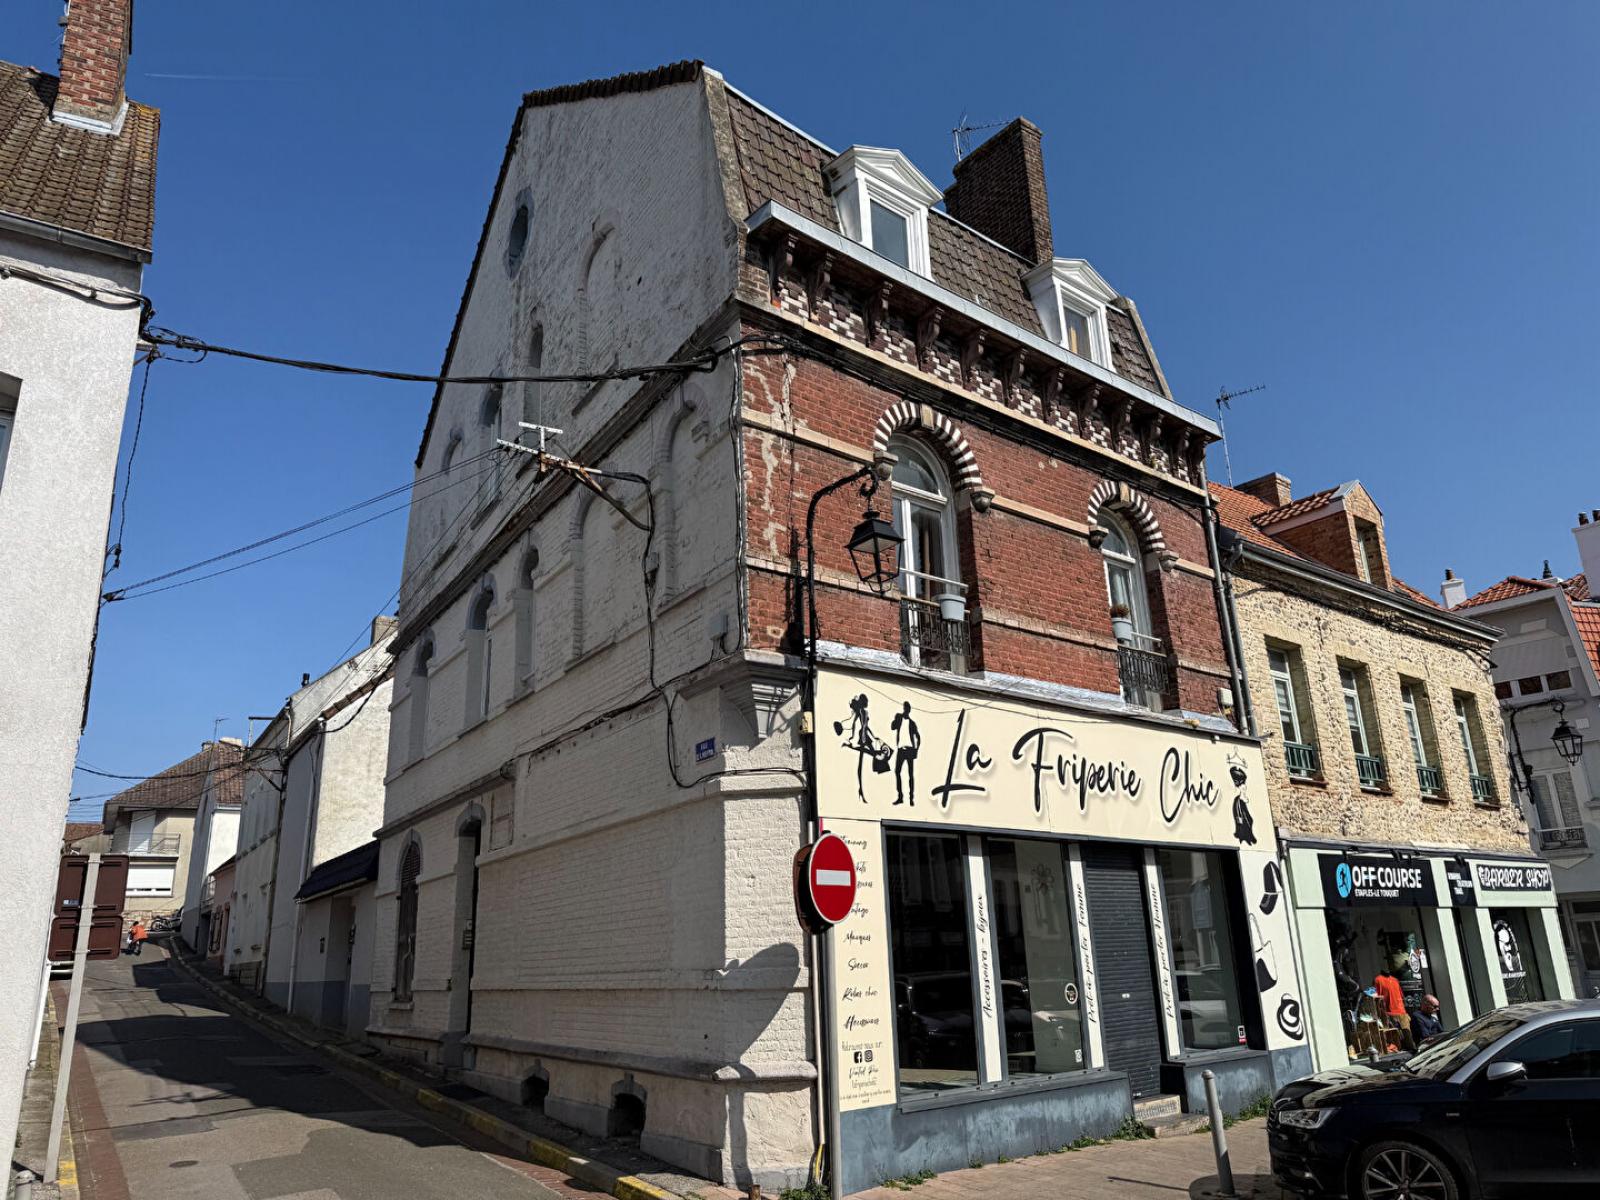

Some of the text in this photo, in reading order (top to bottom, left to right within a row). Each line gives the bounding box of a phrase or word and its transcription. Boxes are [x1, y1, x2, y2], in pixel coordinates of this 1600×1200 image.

[931, 708, 1219, 823] La Friperie Chic
[1377, 866, 1423, 889] COURSE
[1076, 884, 1088, 927] Femme
[981, 950, 993, 1018] Accessoires
